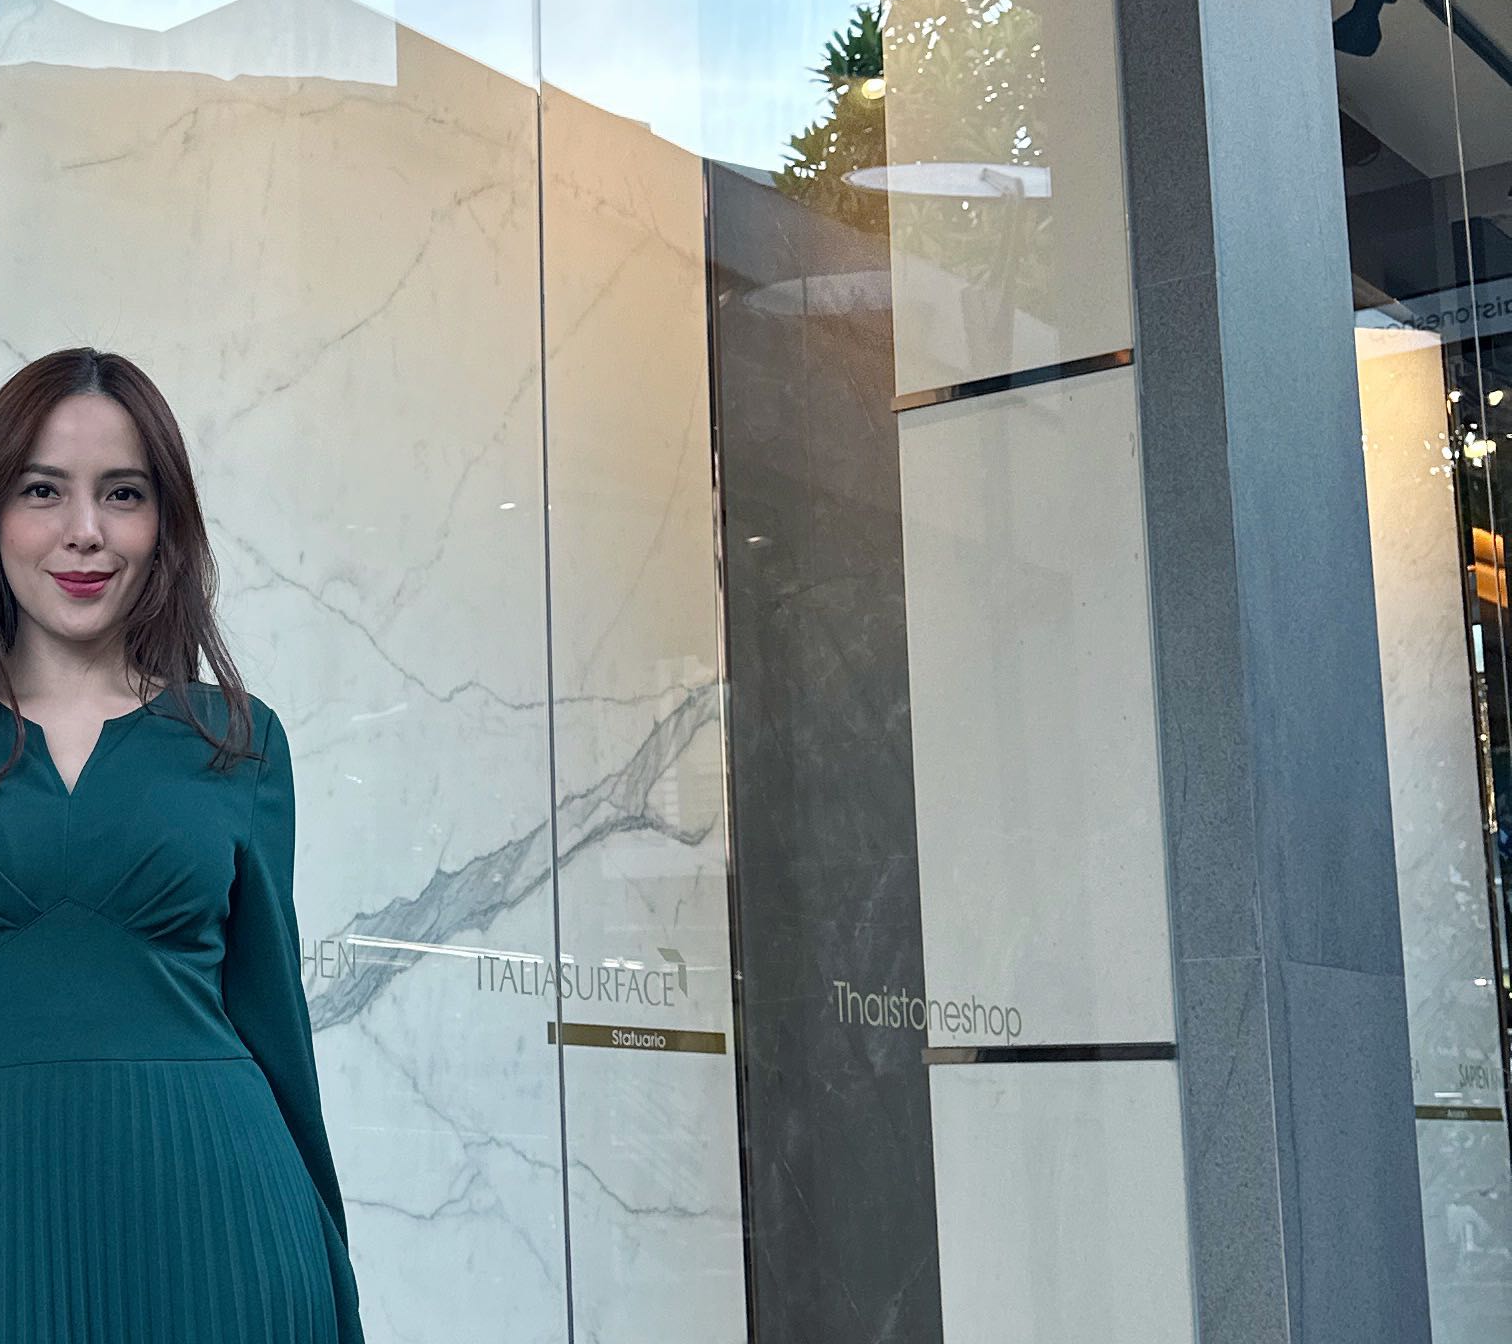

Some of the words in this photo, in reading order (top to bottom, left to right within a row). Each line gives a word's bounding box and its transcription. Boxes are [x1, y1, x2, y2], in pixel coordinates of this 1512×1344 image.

[477, 955, 675, 1007] ITALIASURFACE
[611, 1029, 666, 1048] Statuario
[833, 980, 1022, 1046] Thaistoneshop
